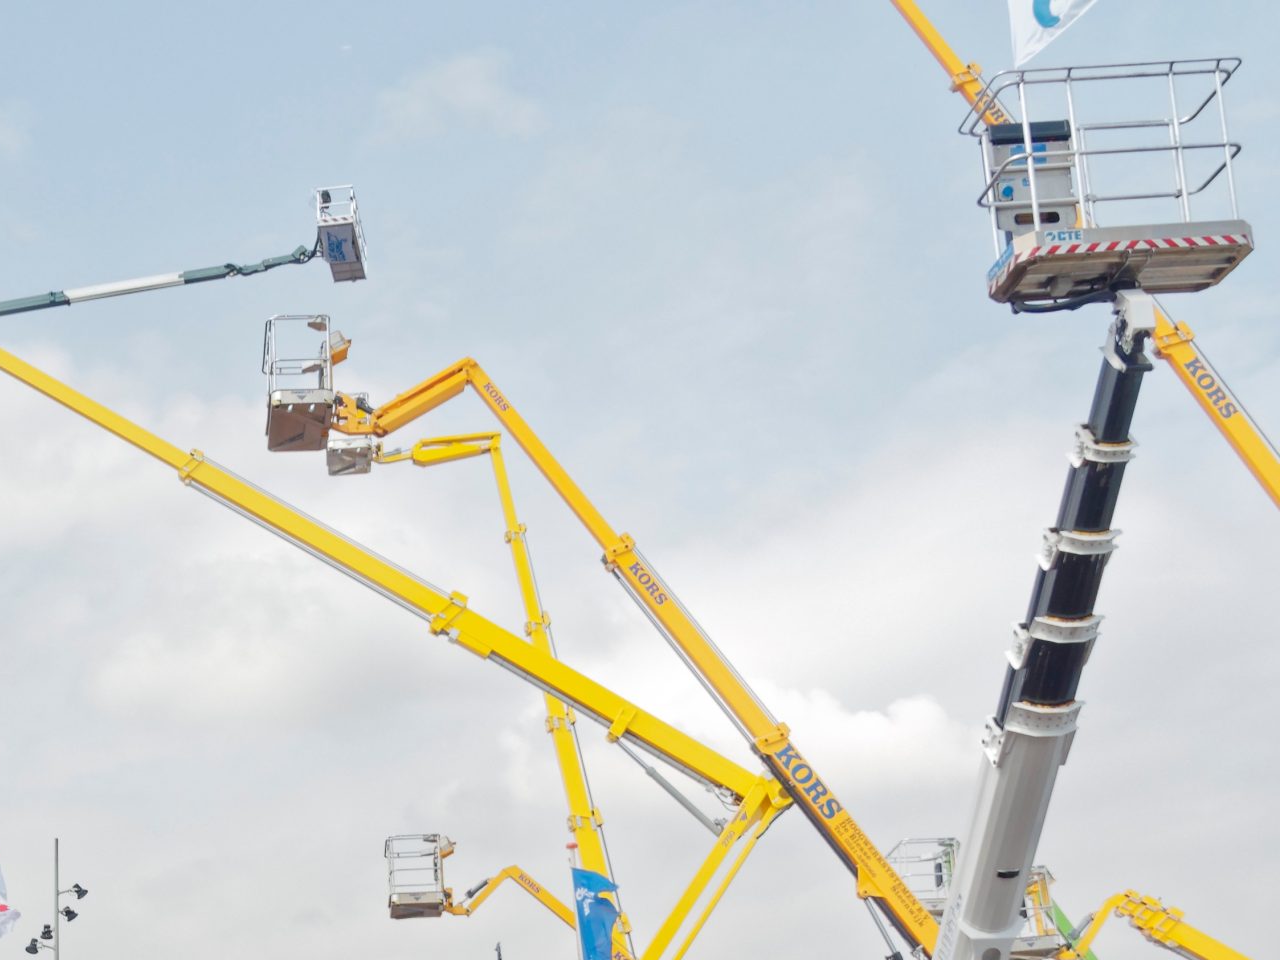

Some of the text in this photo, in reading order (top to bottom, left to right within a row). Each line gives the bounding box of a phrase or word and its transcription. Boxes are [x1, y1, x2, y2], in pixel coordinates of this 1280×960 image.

[1057, 230, 1082, 241] CTE
[483, 382, 509, 412] KORS
[1184, 356, 1238, 418] KORS
[629, 561, 668, 605] KORS
[776, 743, 843, 819] KORS
